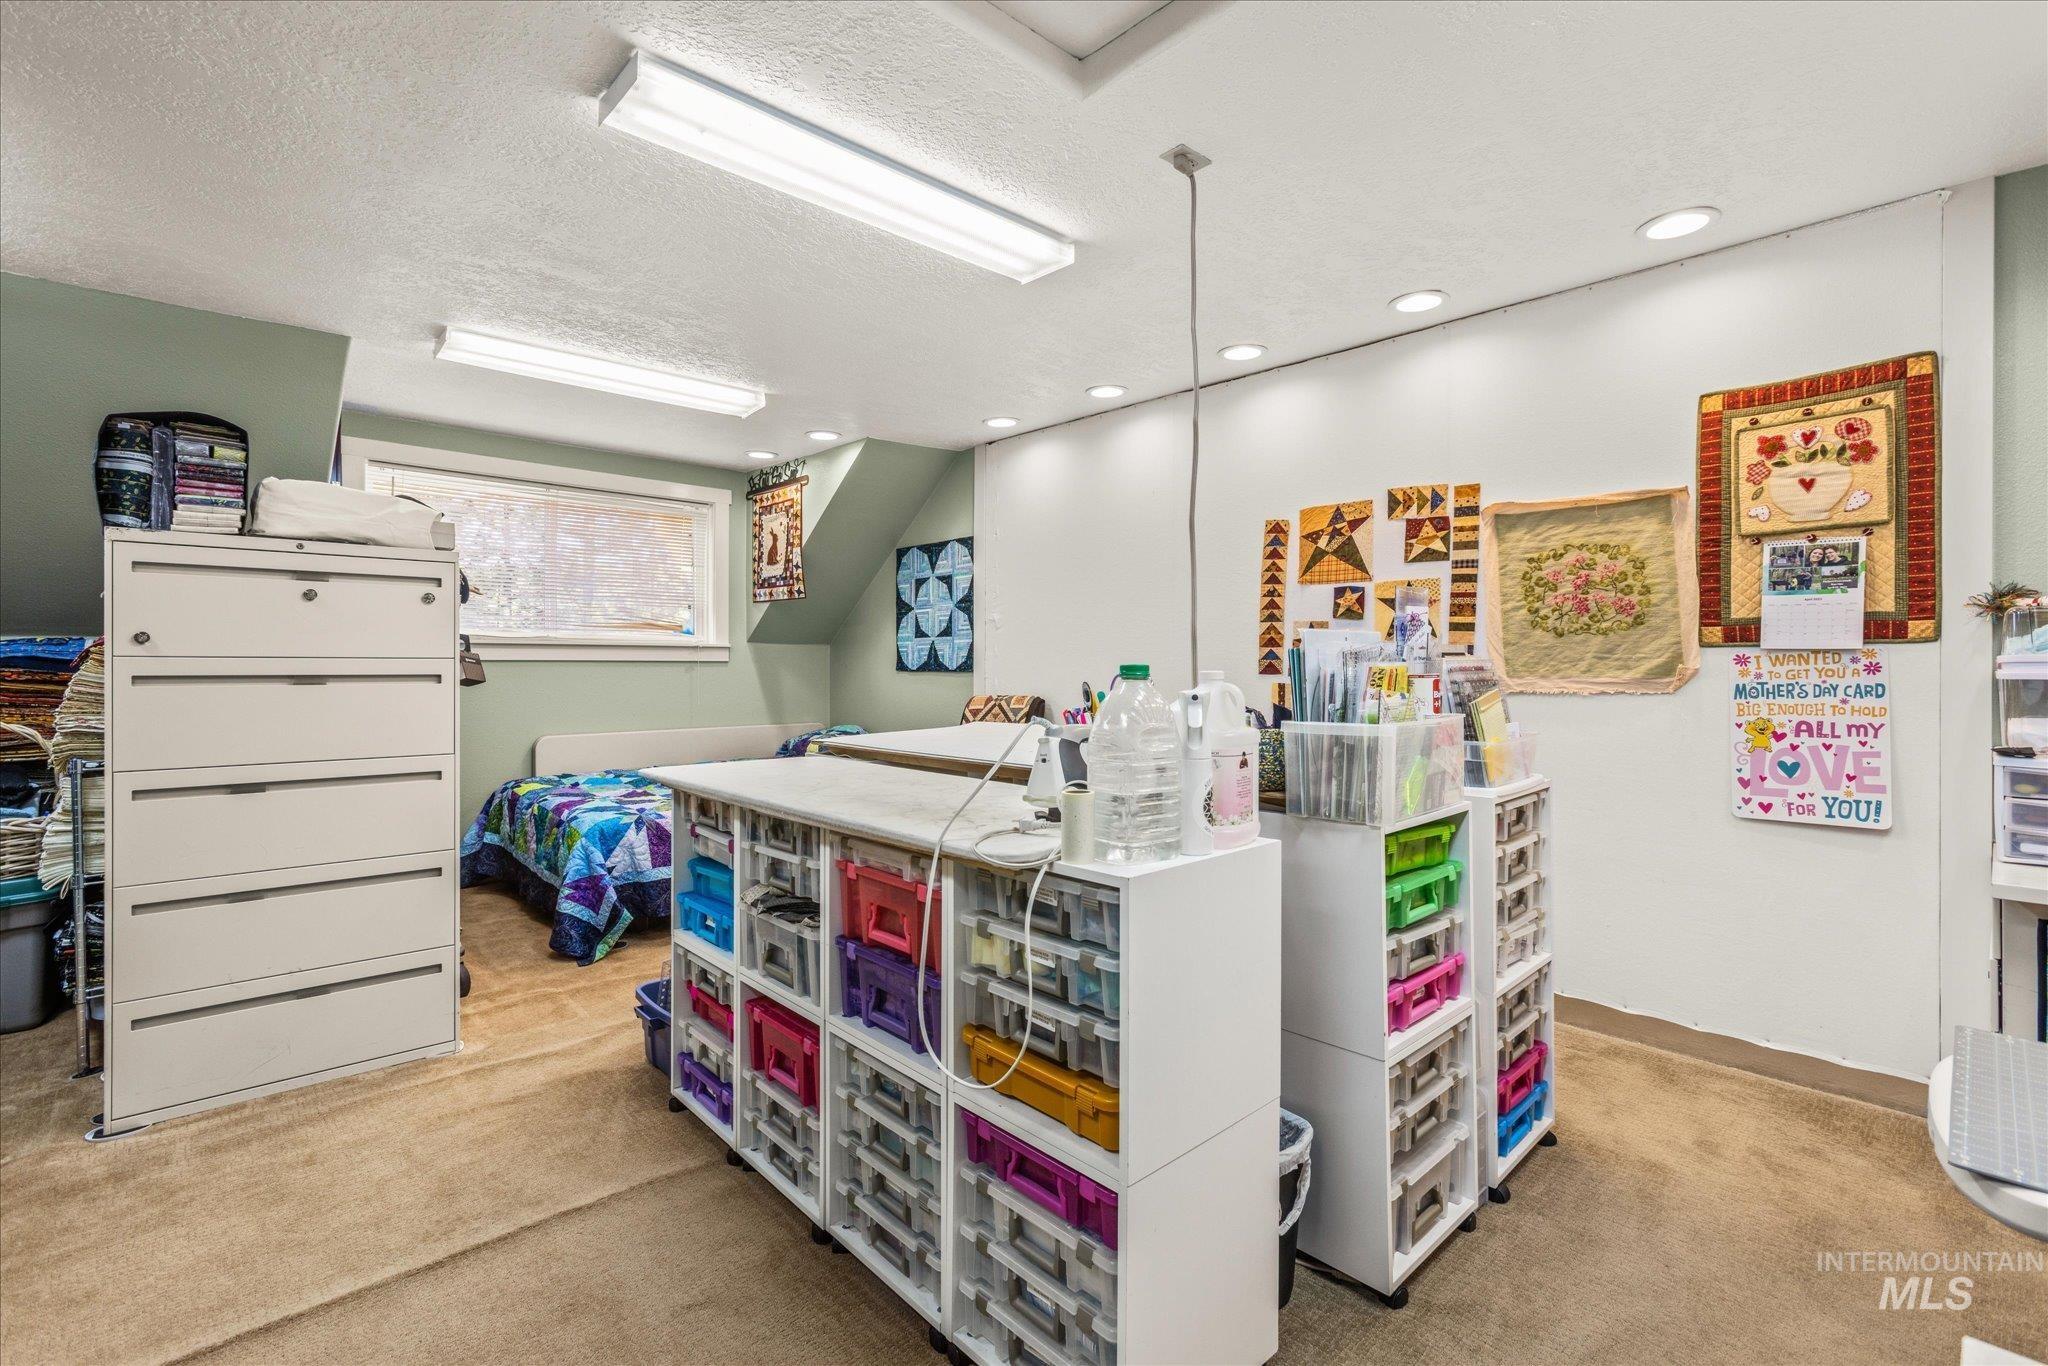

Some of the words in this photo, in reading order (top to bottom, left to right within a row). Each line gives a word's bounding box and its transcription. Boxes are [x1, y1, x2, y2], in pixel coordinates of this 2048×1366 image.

[1754, 655, 1762, 670] I
[1768, 651, 1842, 667] WANTED
[1785, 669, 1810, 680] GET
[1814, 667, 1846, 679] YOU
[1851, 668, 1860, 677] A
[1734, 681, 1809, 700] MOTHER'S
[1813, 683, 1839, 698] DAY
[1843, 682, 1886, 699] CARD
[1766, 702, 1826, 717] ENOUGH
[1851, 705, 1887, 718] HOLD
[1794, 720, 1841, 739] ALL
[1748, 744, 1887, 798] LOVE
[1787, 801, 1816, 817] FOR
[1821, 796, 1883, 824] YOU!
